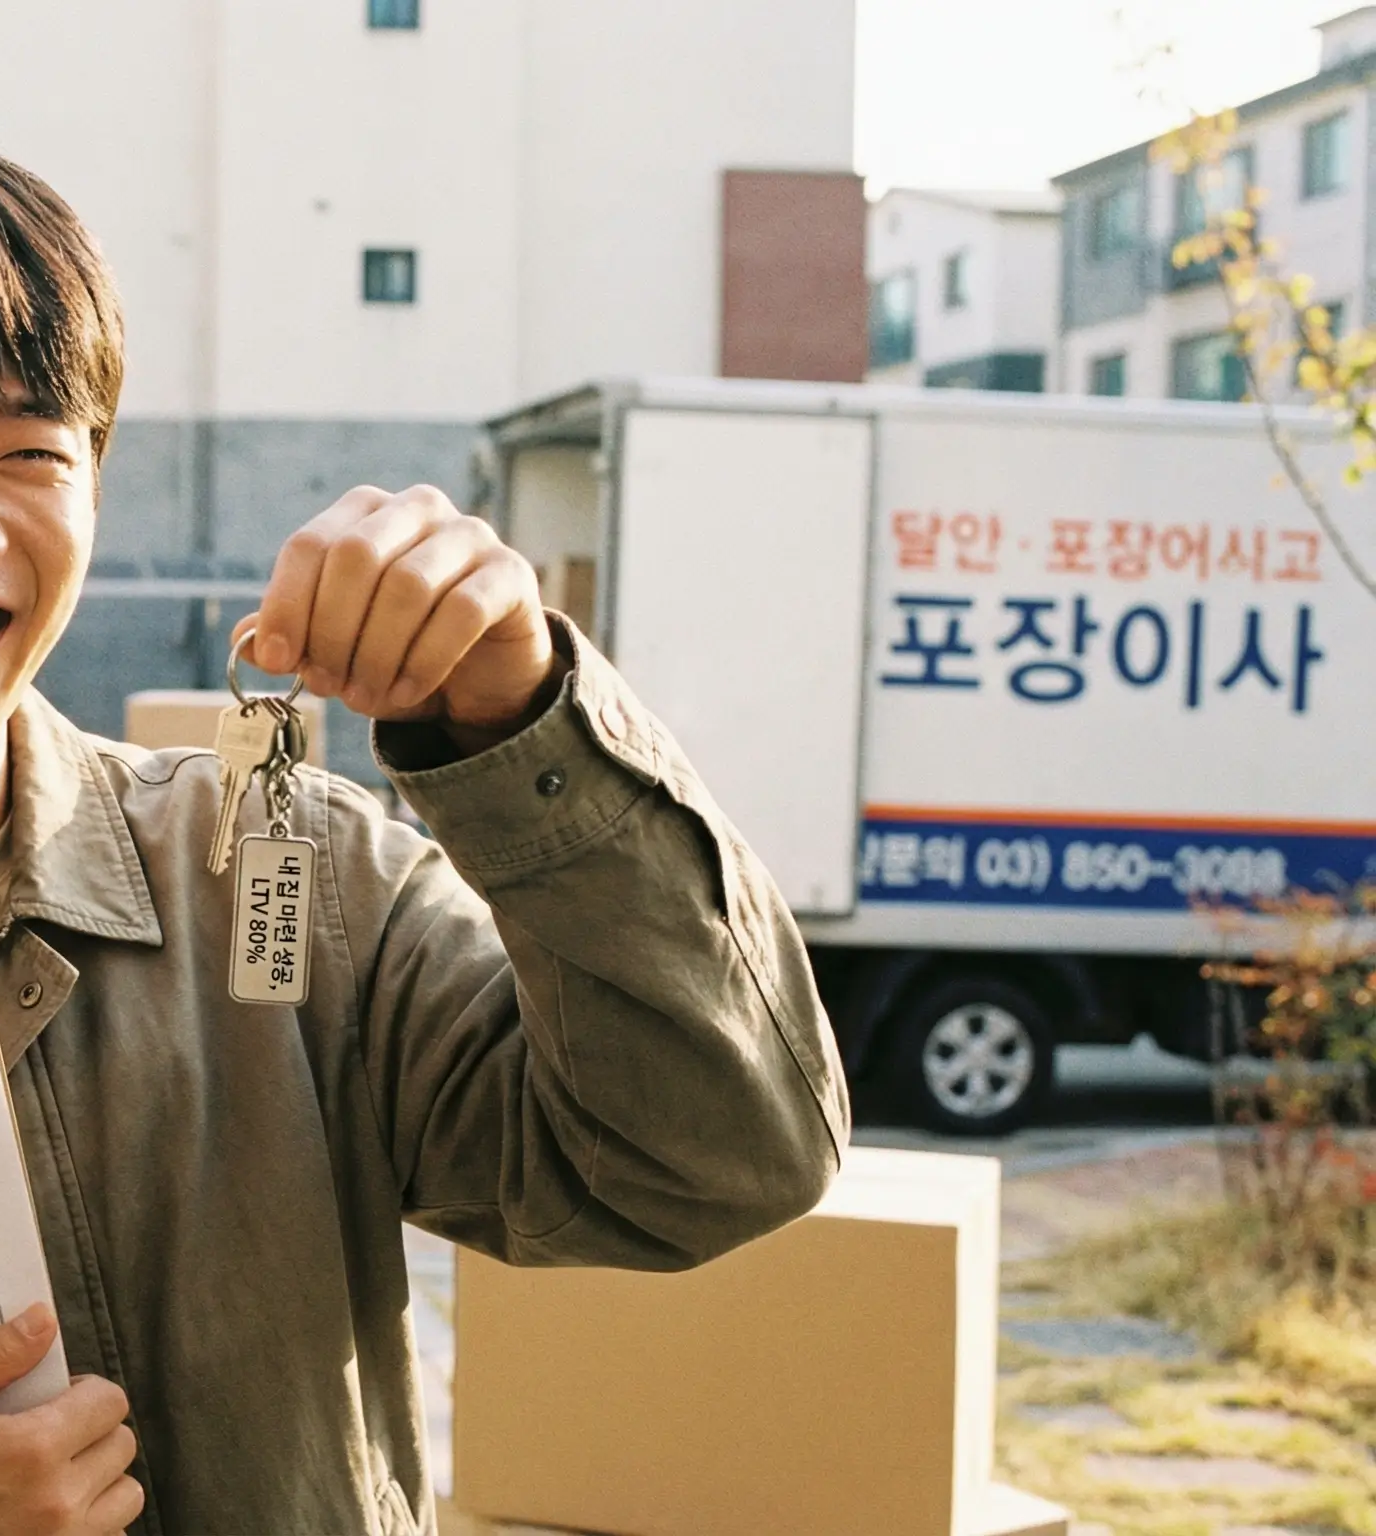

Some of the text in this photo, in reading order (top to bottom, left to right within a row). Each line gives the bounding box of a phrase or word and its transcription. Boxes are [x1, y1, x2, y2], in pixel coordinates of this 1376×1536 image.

[879, 594, 1324, 713] 포장이사
[246, 878, 271, 965] LTV 80%
[268, 856, 301, 991] 내 집 마련 성공,
